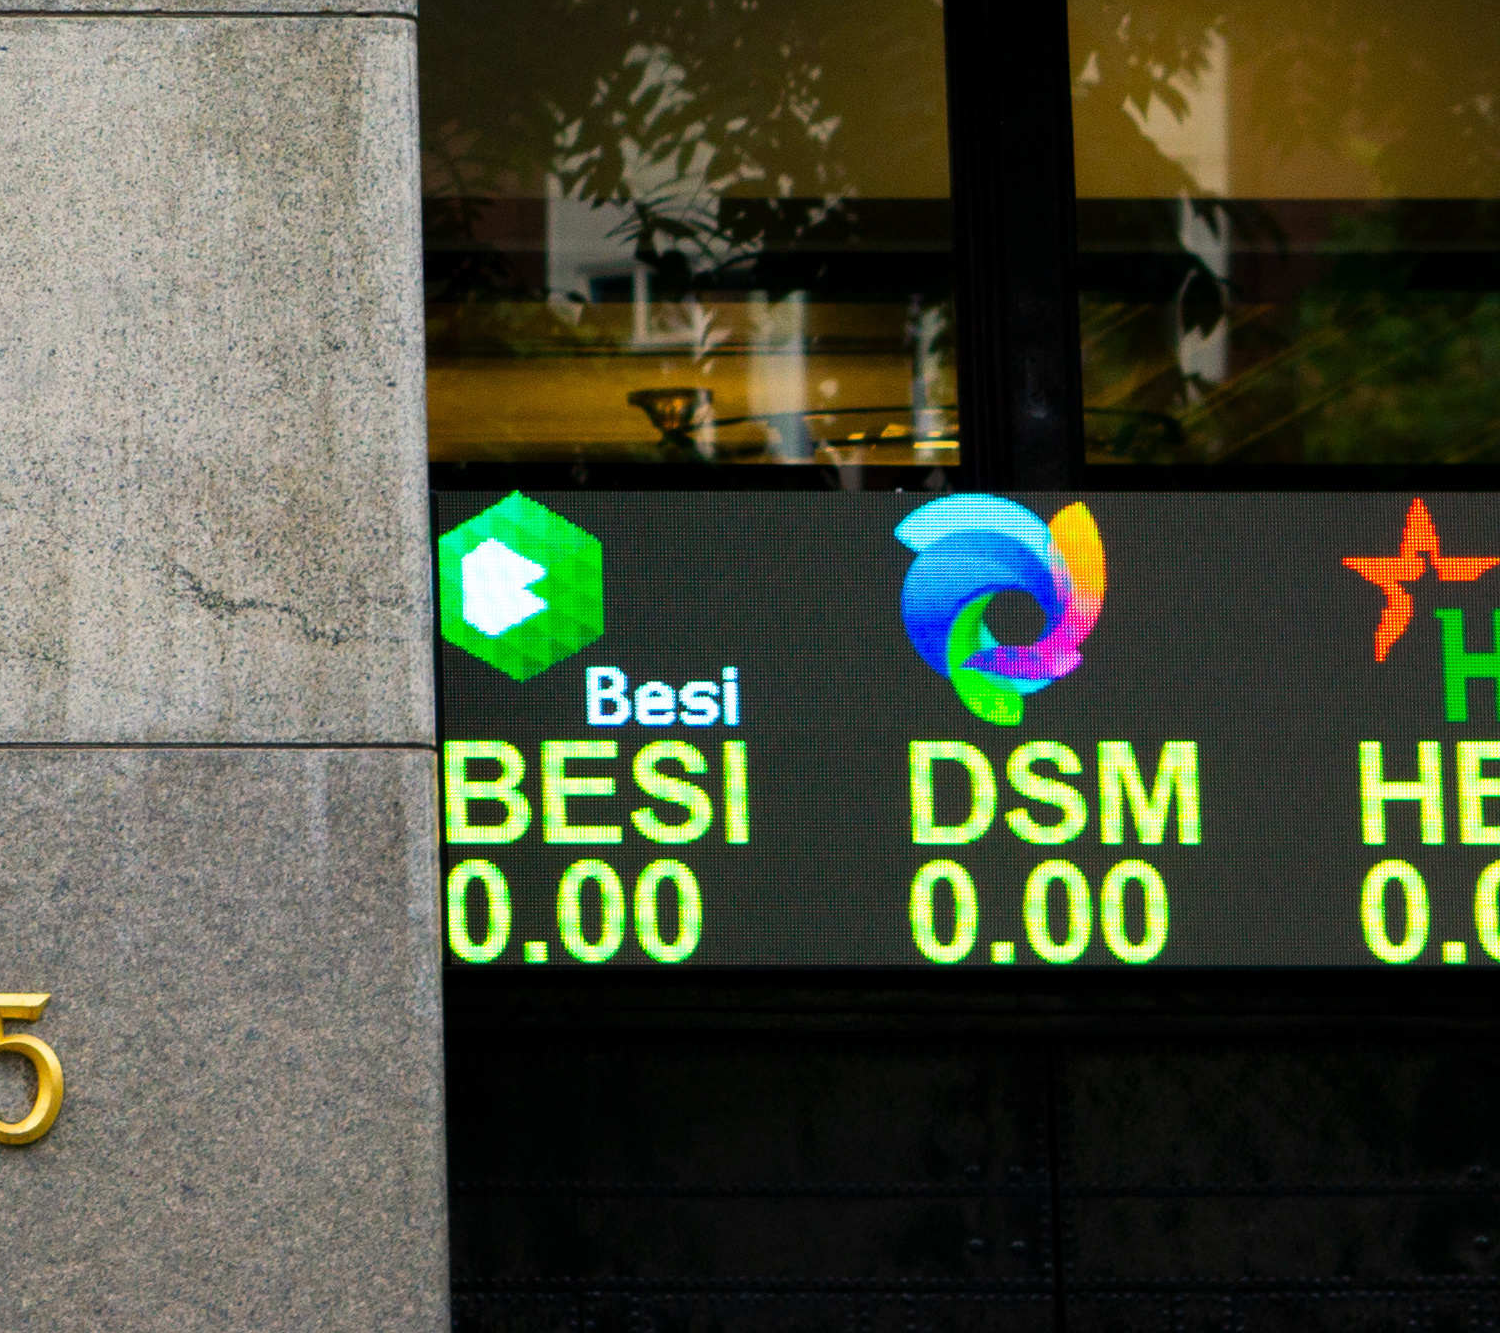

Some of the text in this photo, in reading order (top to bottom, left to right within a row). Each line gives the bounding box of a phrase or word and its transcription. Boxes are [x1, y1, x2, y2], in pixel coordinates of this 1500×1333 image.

[586, 666, 740, 727] Besi
[444, 740, 750, 844] BESI
[909, 740, 1201, 845] DSM
[447, 859, 703, 963] 0.00
[909, 859, 1169, 964] 0.00
